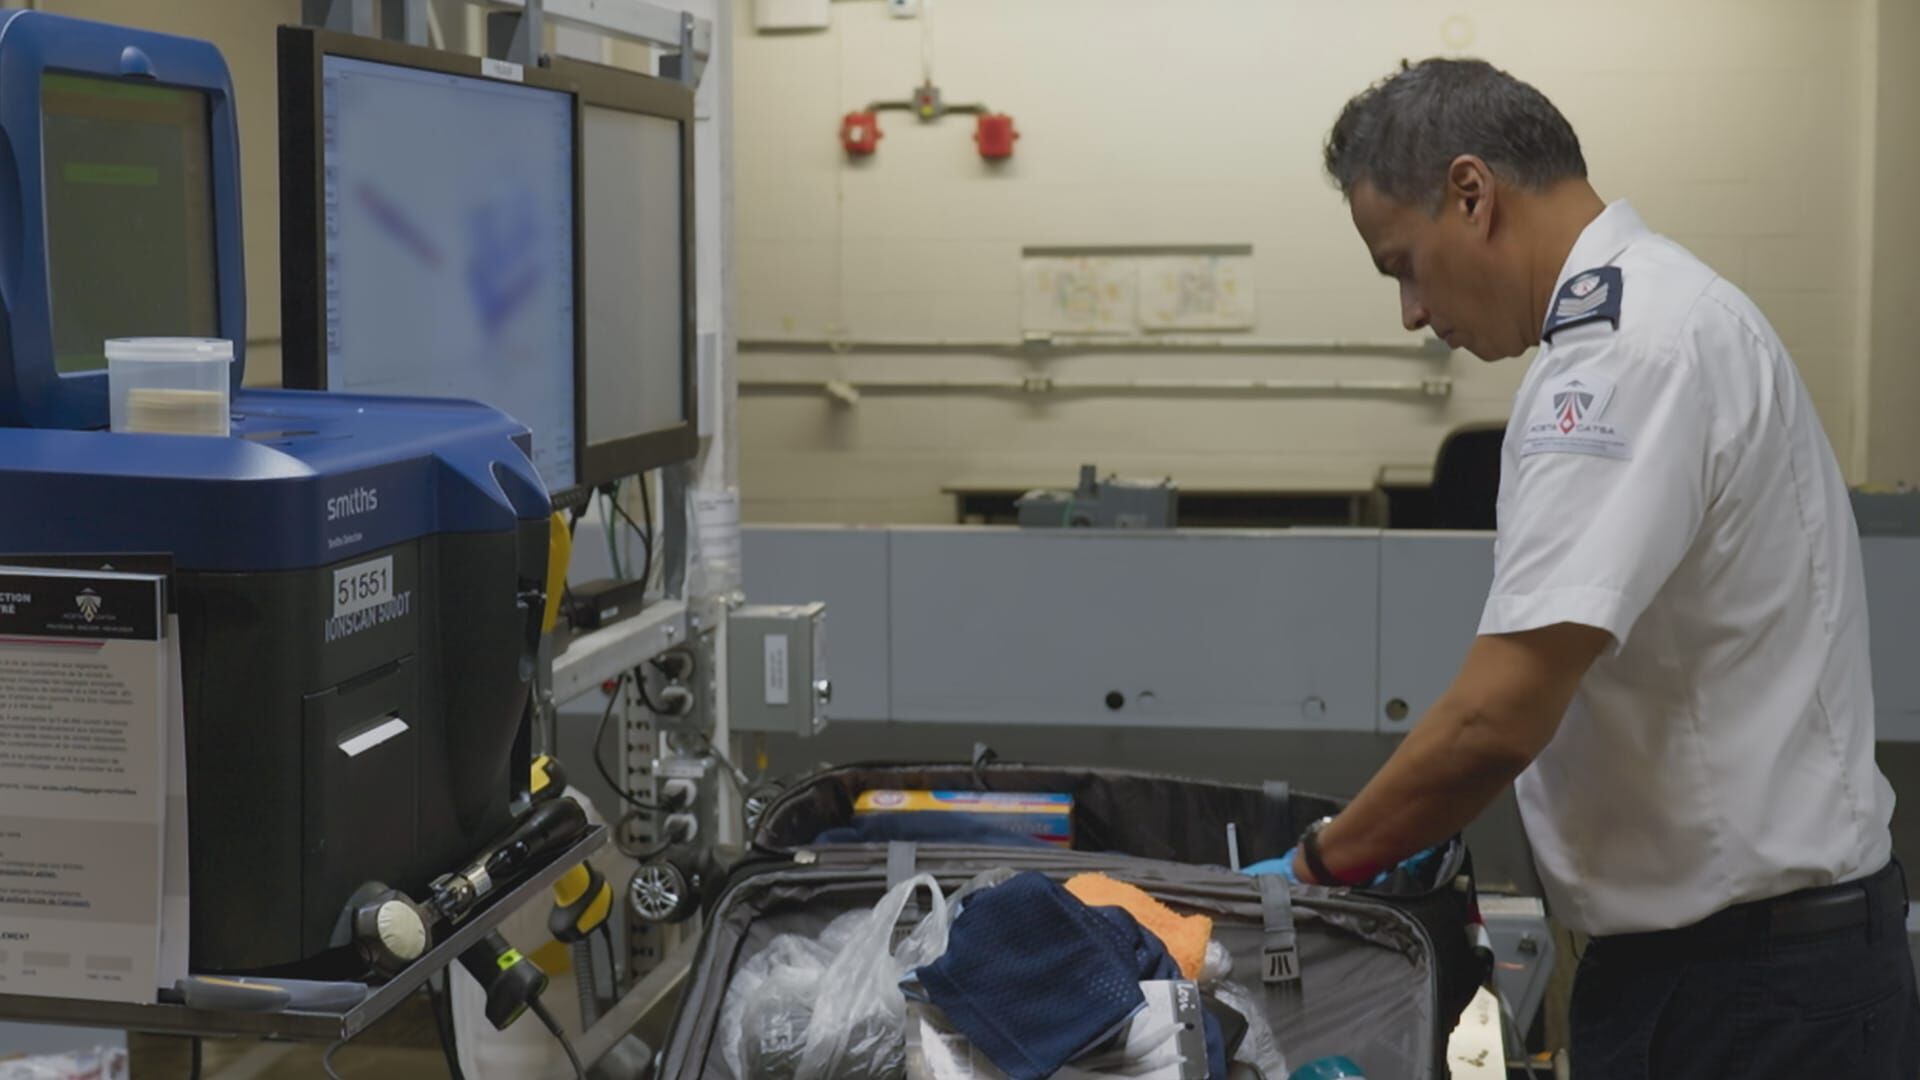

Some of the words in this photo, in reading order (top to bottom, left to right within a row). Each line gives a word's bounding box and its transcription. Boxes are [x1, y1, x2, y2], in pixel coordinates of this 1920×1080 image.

[1576, 423, 1614, 434] CATSA
[327, 487, 377, 520] smiths
[338, 568, 387, 605] 51551
[326, 607, 377, 643] IONSCAN
